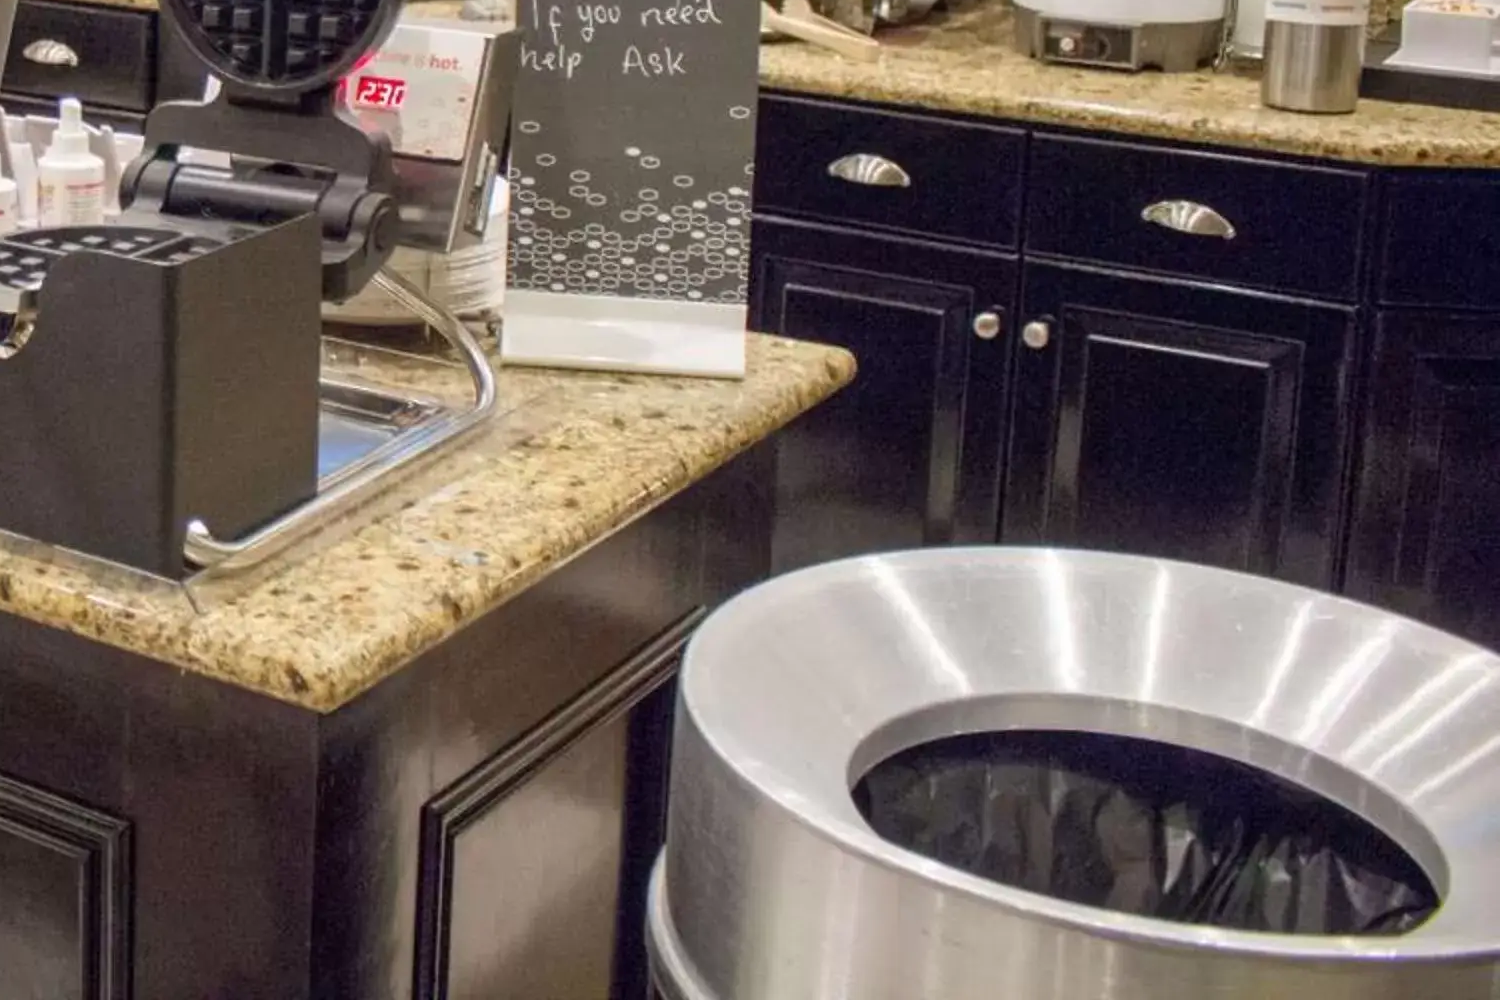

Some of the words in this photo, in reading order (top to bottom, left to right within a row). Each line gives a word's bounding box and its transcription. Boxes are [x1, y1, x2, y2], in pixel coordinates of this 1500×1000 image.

[576, 4, 622, 42] you
[520, 42, 583, 79] help
[621, 44, 688, 78] Ask
